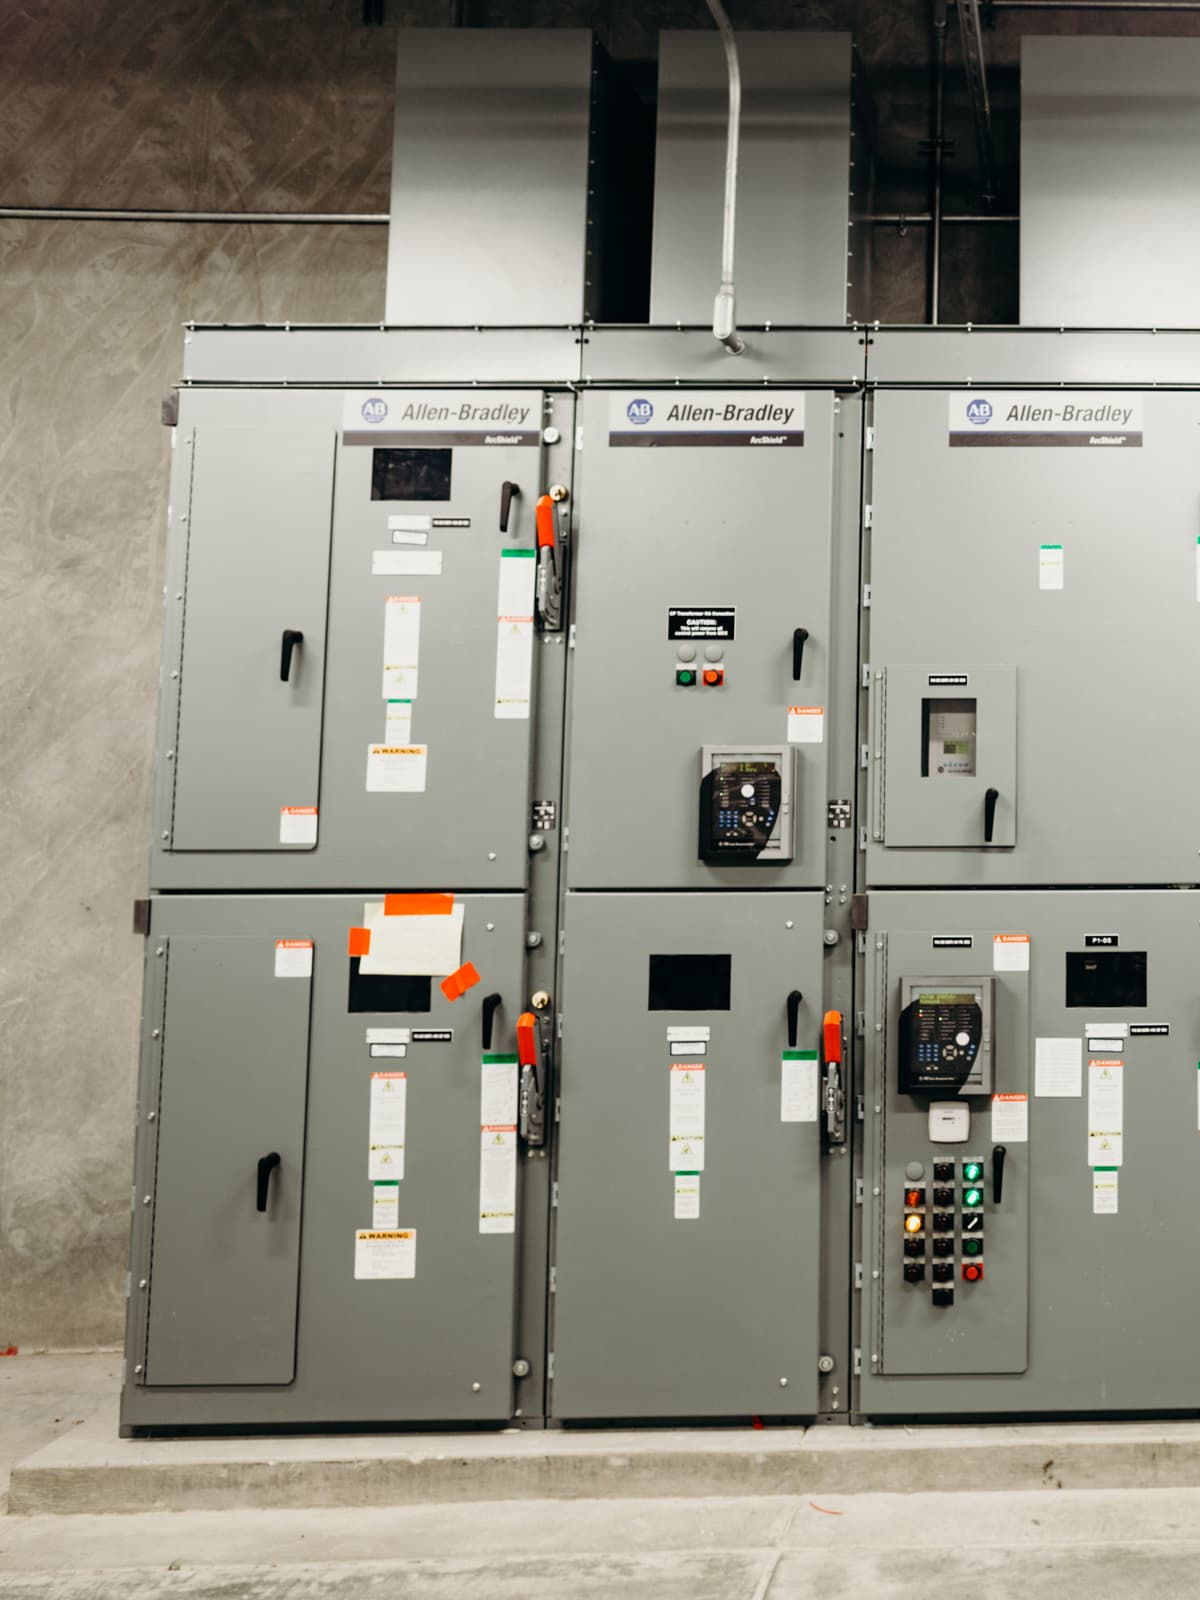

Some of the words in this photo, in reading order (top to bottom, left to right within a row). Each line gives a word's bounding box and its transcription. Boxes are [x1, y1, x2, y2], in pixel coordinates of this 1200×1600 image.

[401, 403, 530, 425] Allen-Bradley
[666, 404, 795, 425] Allen-Bradley
[1006, 404, 1133, 426] Allen-Bradley
